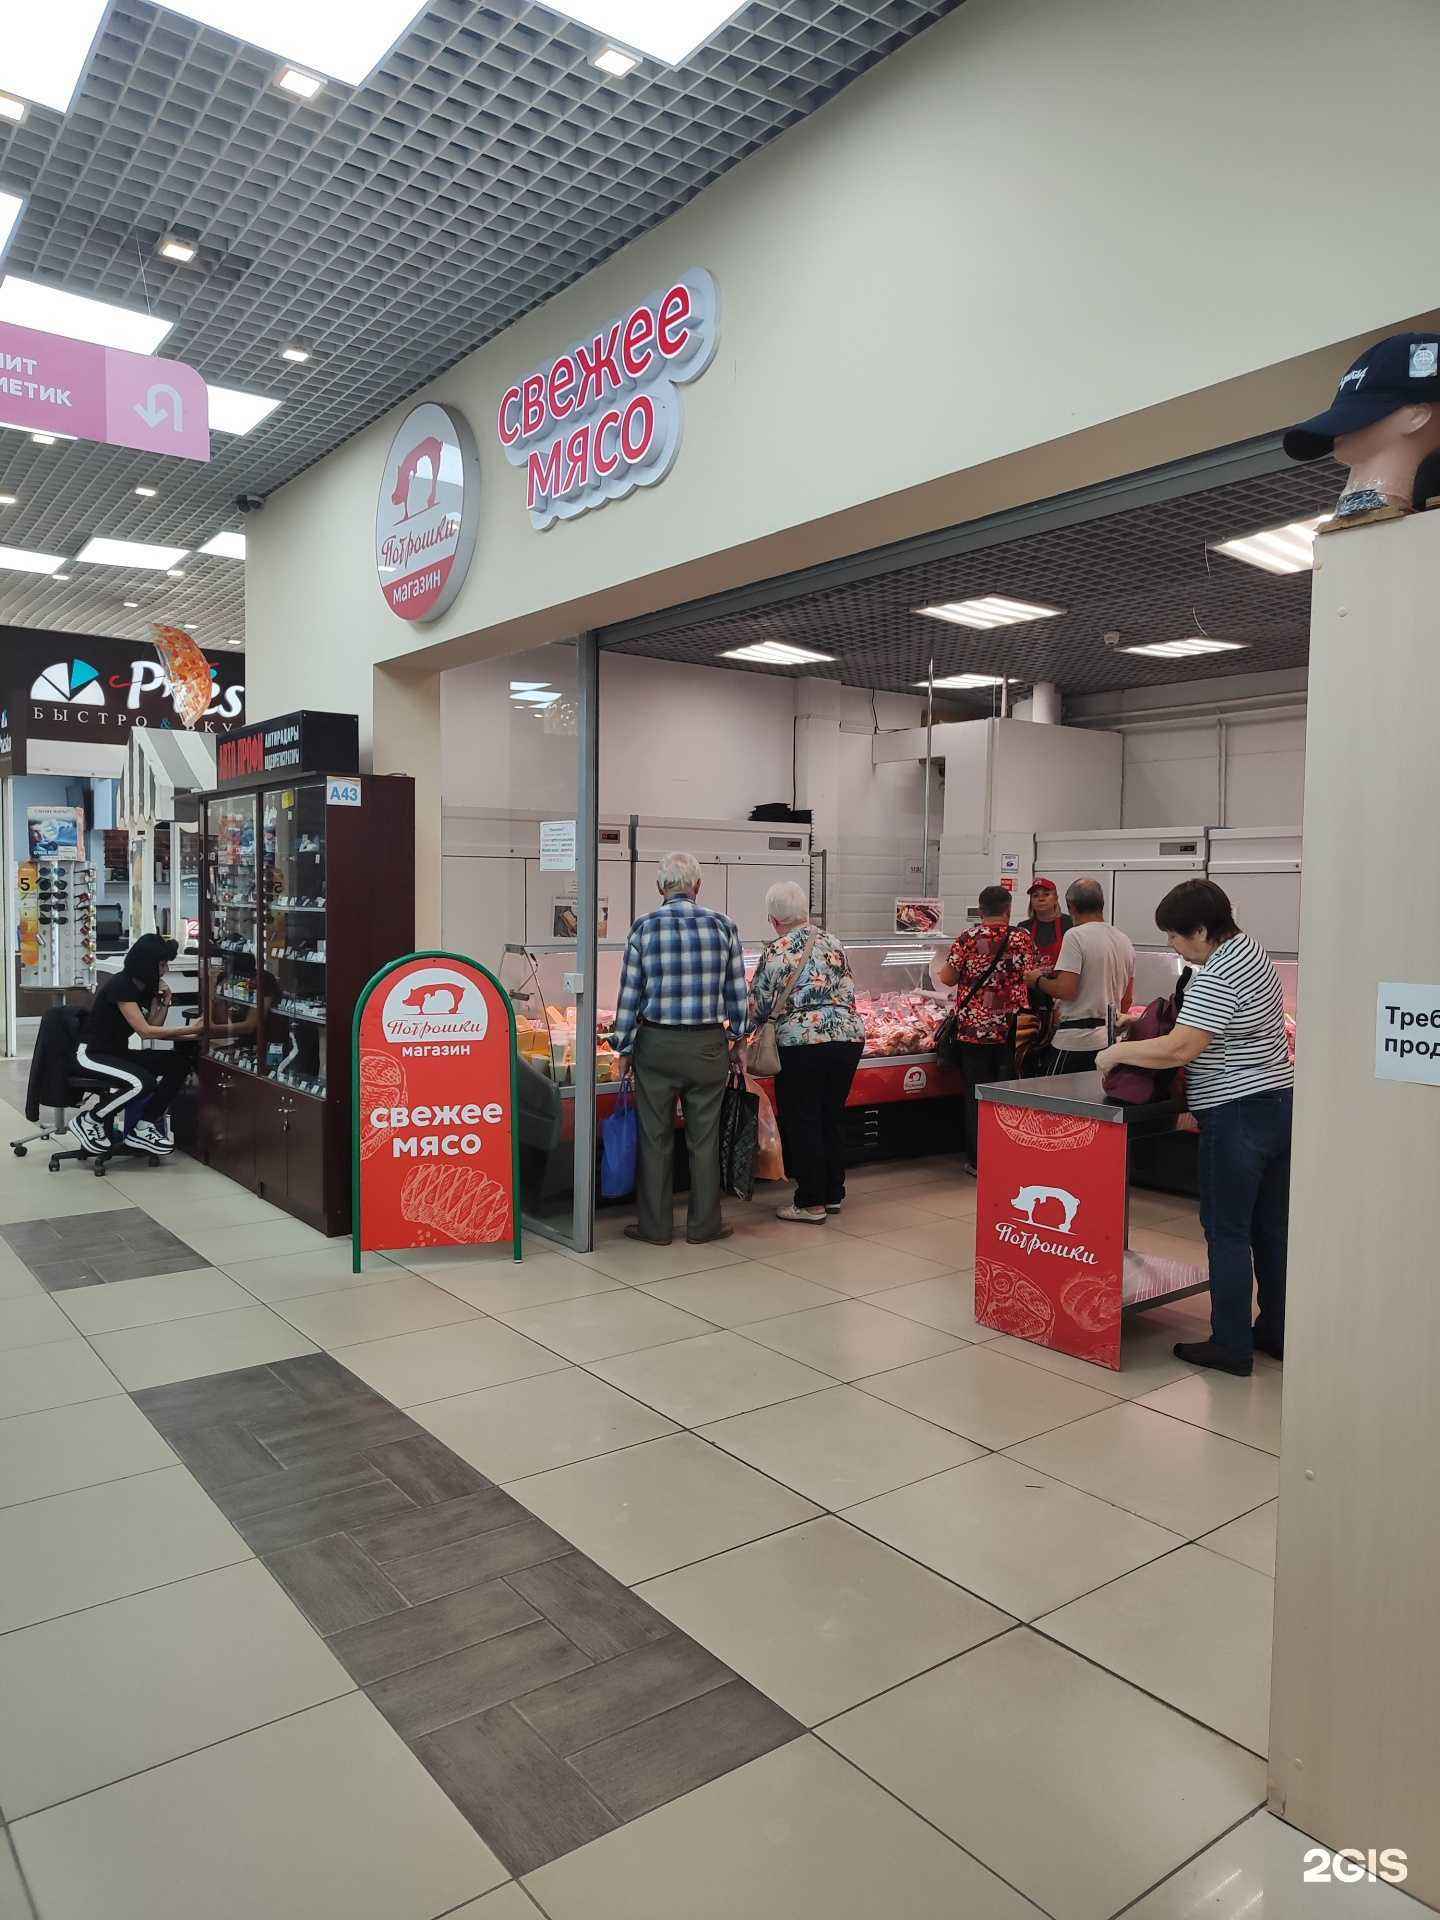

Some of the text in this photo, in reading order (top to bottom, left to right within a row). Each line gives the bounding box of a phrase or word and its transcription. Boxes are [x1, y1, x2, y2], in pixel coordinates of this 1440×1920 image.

[0, 352, 38, 375] ИТ
[497, 284, 693, 447] свежее
[526, 394, 655, 510] мясо
[392, 571, 442, 606] магазин
[32, 706, 148, 728] БЫСТРО
[330, 784, 358, 801] A43
[386, 1018, 484, 1037] Потрошки
[1384, 1005, 1440, 1030] Треб
[401, 1042, 472, 1058] магазин
[369, 1102, 504, 1129] свежее
[392, 1133, 482, 1158] мясо
[995, 1222, 1099, 1265] Потрошки
